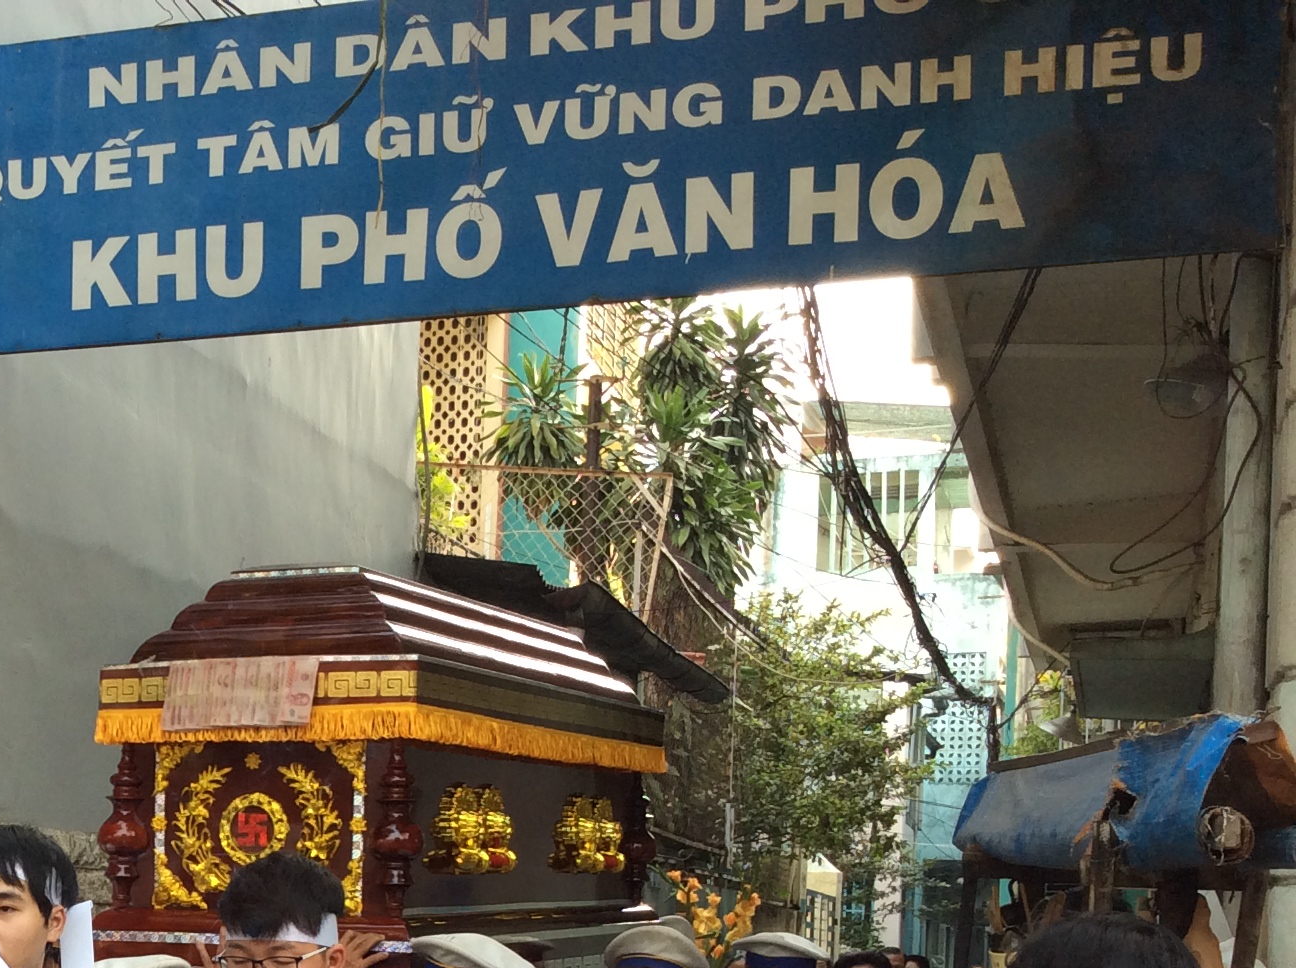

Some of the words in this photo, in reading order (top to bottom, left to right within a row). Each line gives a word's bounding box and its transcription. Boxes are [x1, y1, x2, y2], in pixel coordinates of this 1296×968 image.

[88, 38, 311, 108] NHÂN
[335, 15, 507, 78] DÂN
[530, 0, 716, 56] KHU
[197, 119, 340, 178] TÂM
[364, 94, 494, 162] GIỮ
[513, 83, 723, 145] VỮNG
[752, 54, 972, 121] DANH
[1004, 27, 1203, 105] HIỆU
[70, 220, 264, 311] KHU
[300, 166, 507, 291] PHỐ
[535, 157, 755, 268] VĂN
[787, 128, 1026, 247] HÓA
